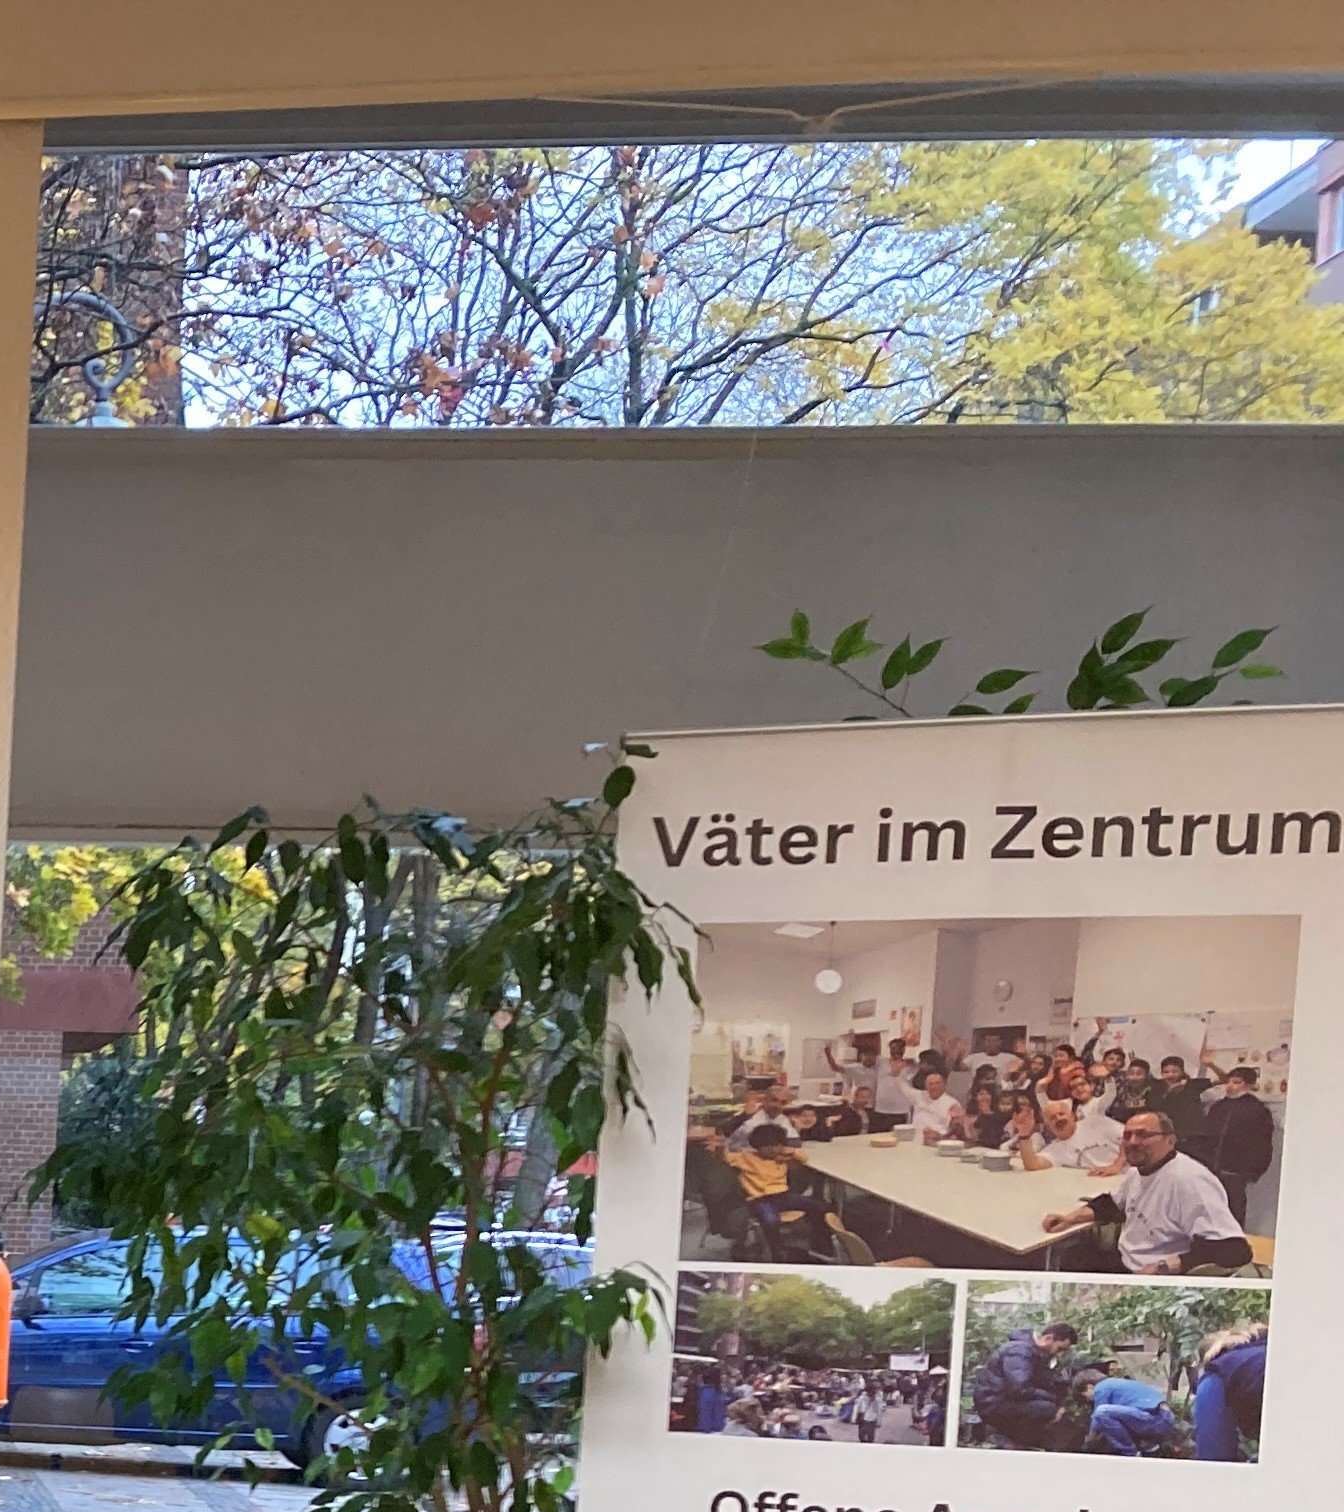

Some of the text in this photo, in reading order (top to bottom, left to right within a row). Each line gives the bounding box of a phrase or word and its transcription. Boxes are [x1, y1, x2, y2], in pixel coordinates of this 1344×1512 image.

[653, 804, 1343, 868] Väter im Zentrum
